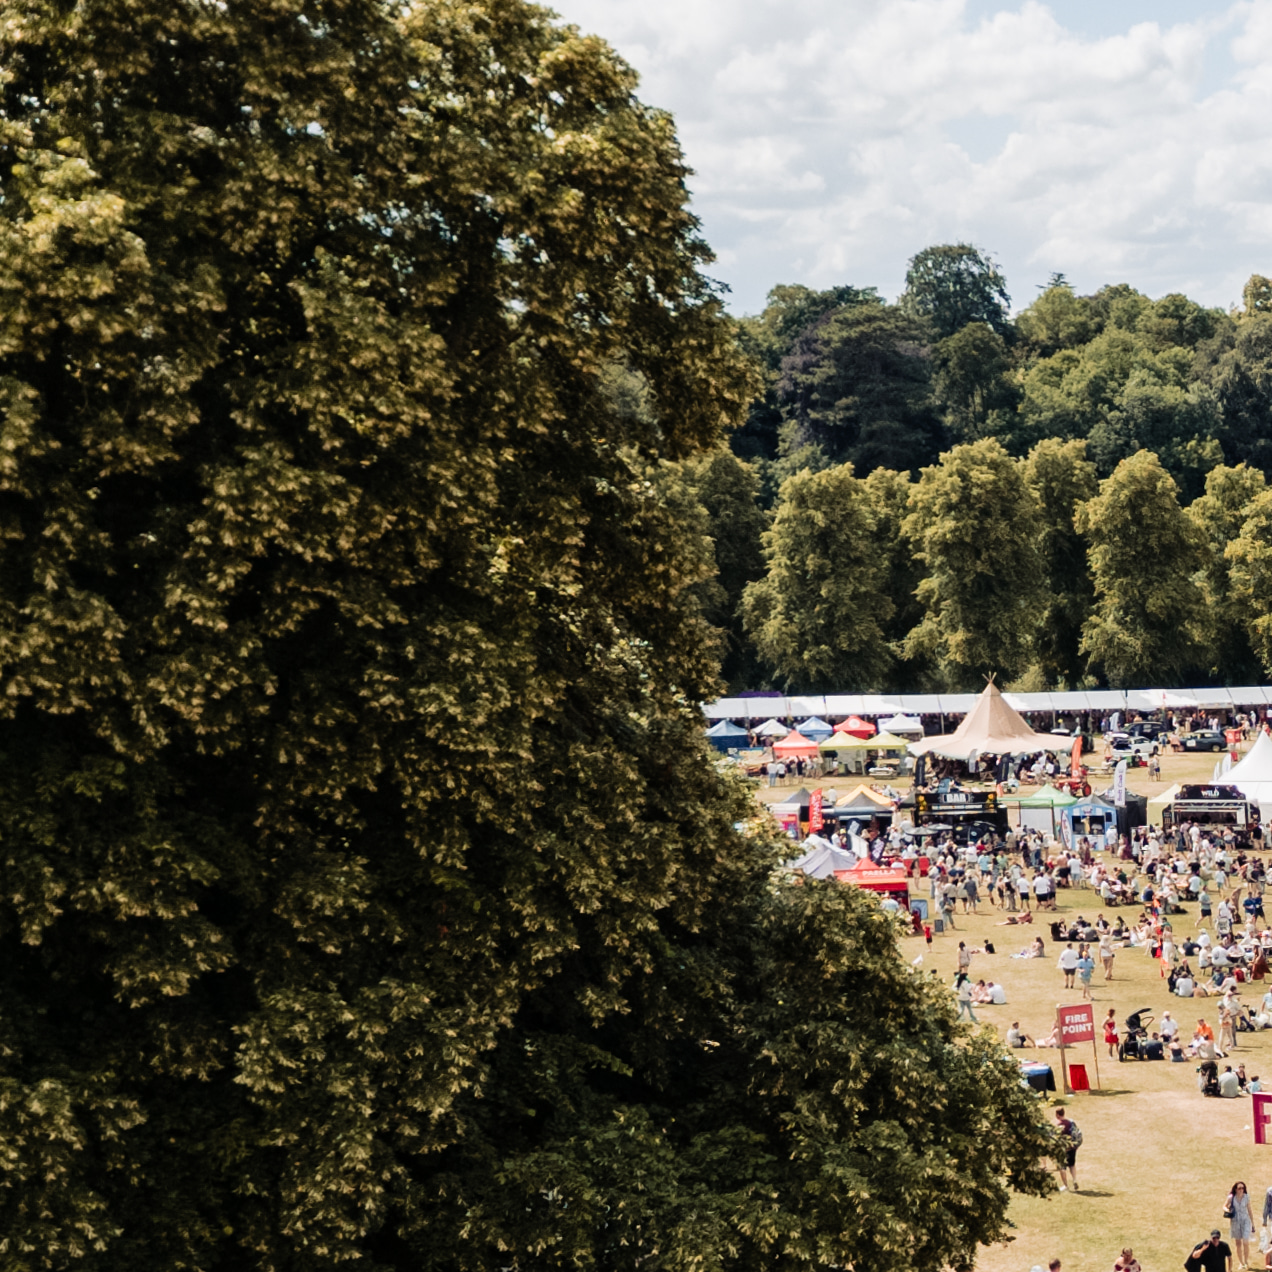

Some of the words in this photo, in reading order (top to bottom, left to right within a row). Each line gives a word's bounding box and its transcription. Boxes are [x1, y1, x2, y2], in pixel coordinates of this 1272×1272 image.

[946, 793, 967, 803] BAR
[862, 869, 896, 877] PAELLA
[1065, 1013, 1088, 1025] FIRE
[1062, 1023, 1093, 1035] POINT
